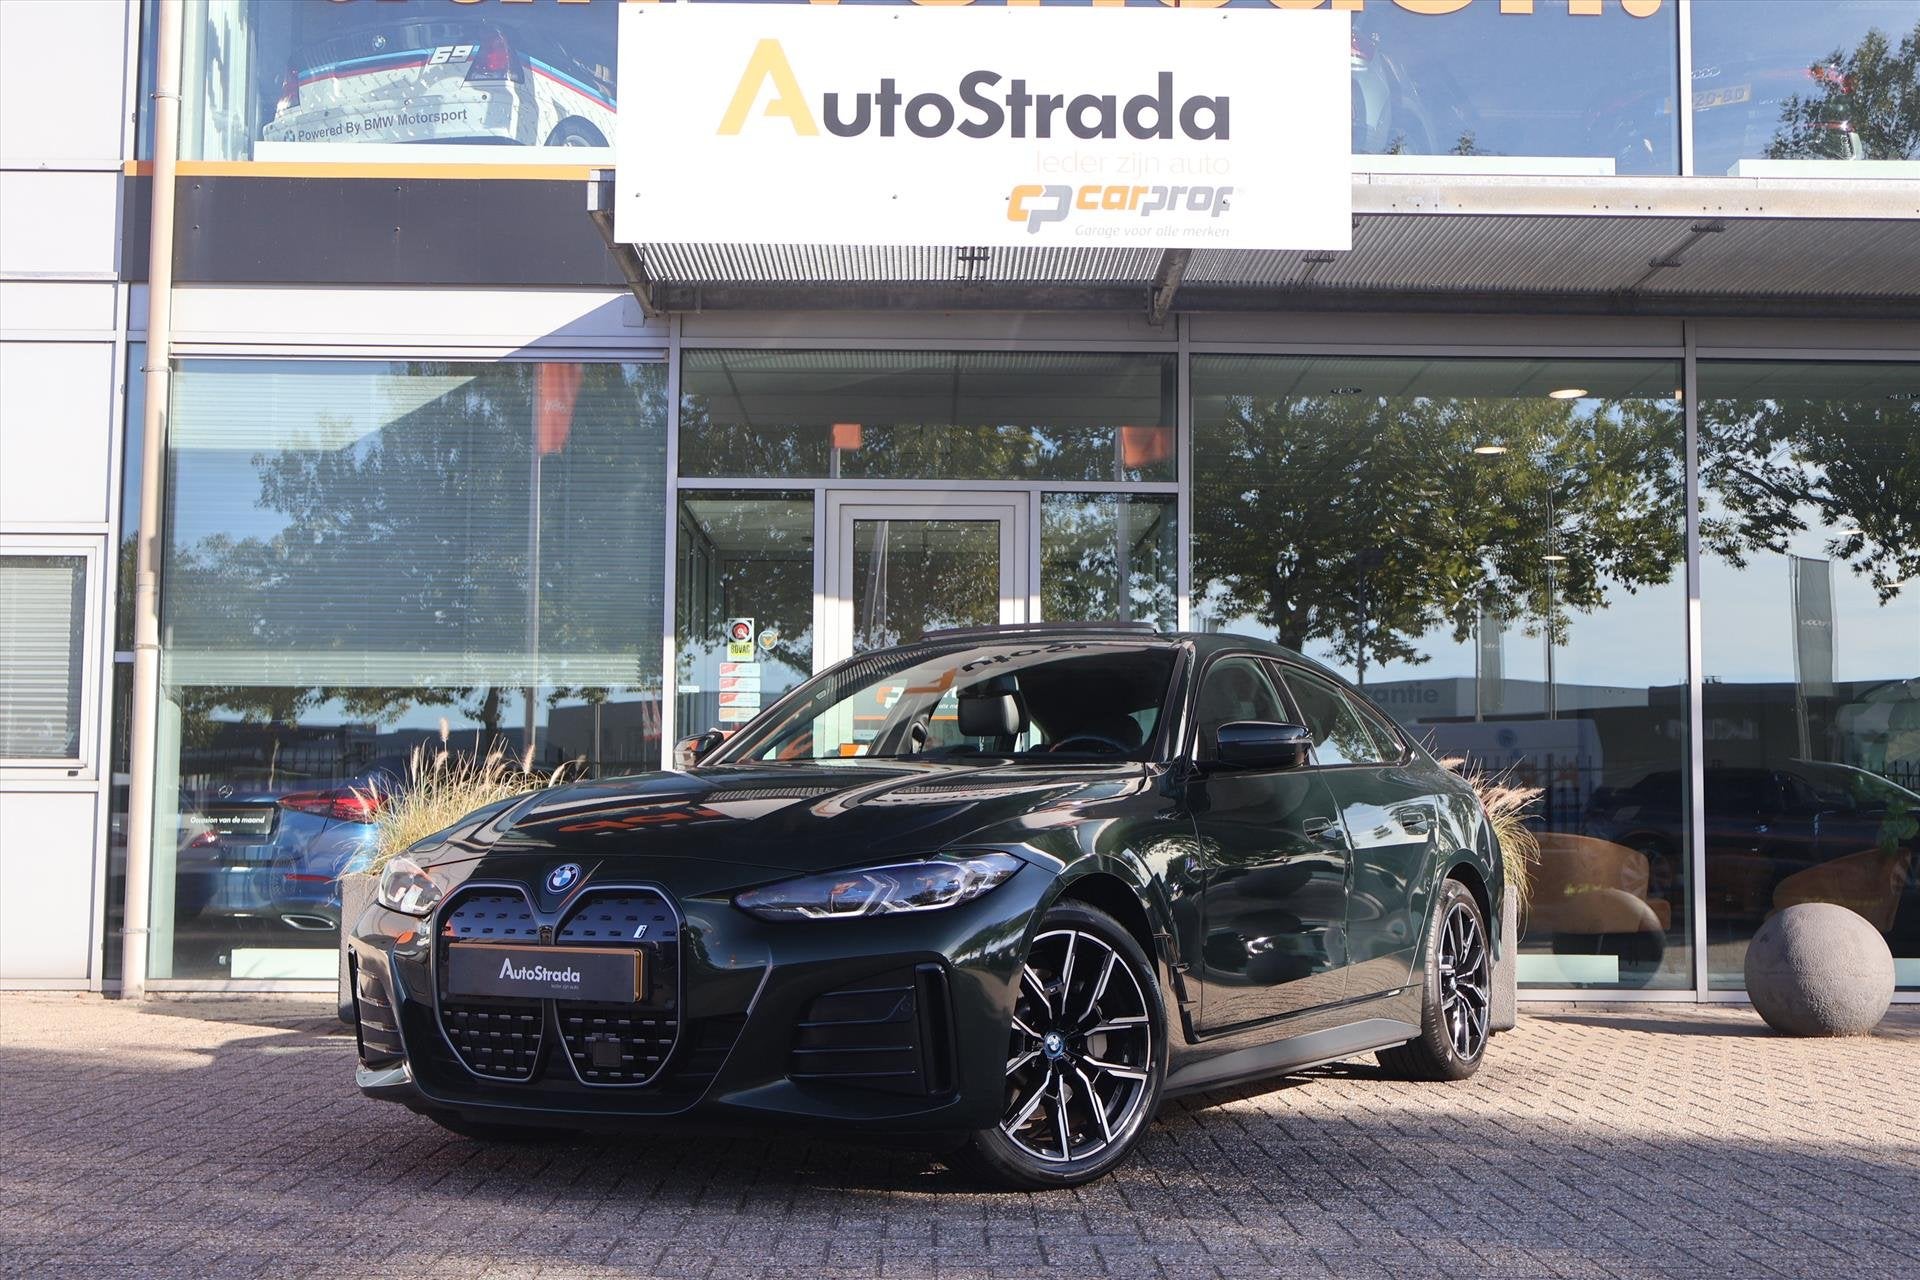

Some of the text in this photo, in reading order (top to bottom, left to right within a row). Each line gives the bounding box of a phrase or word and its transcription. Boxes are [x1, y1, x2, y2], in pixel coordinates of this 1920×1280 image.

[428, 44, 474, 65] 69
[716, 38, 1231, 141] AutoStrada
[298, 108, 467, 141] Powered By BMW Motorsport
[1117, 151, 1160, 180] zijn
[1170, 154, 1232, 175] auto
[1075, 224, 1230, 239] Garage voor alle merken
[232, 815, 241, 824] de
[498, 957, 581, 983] AutoStrada
